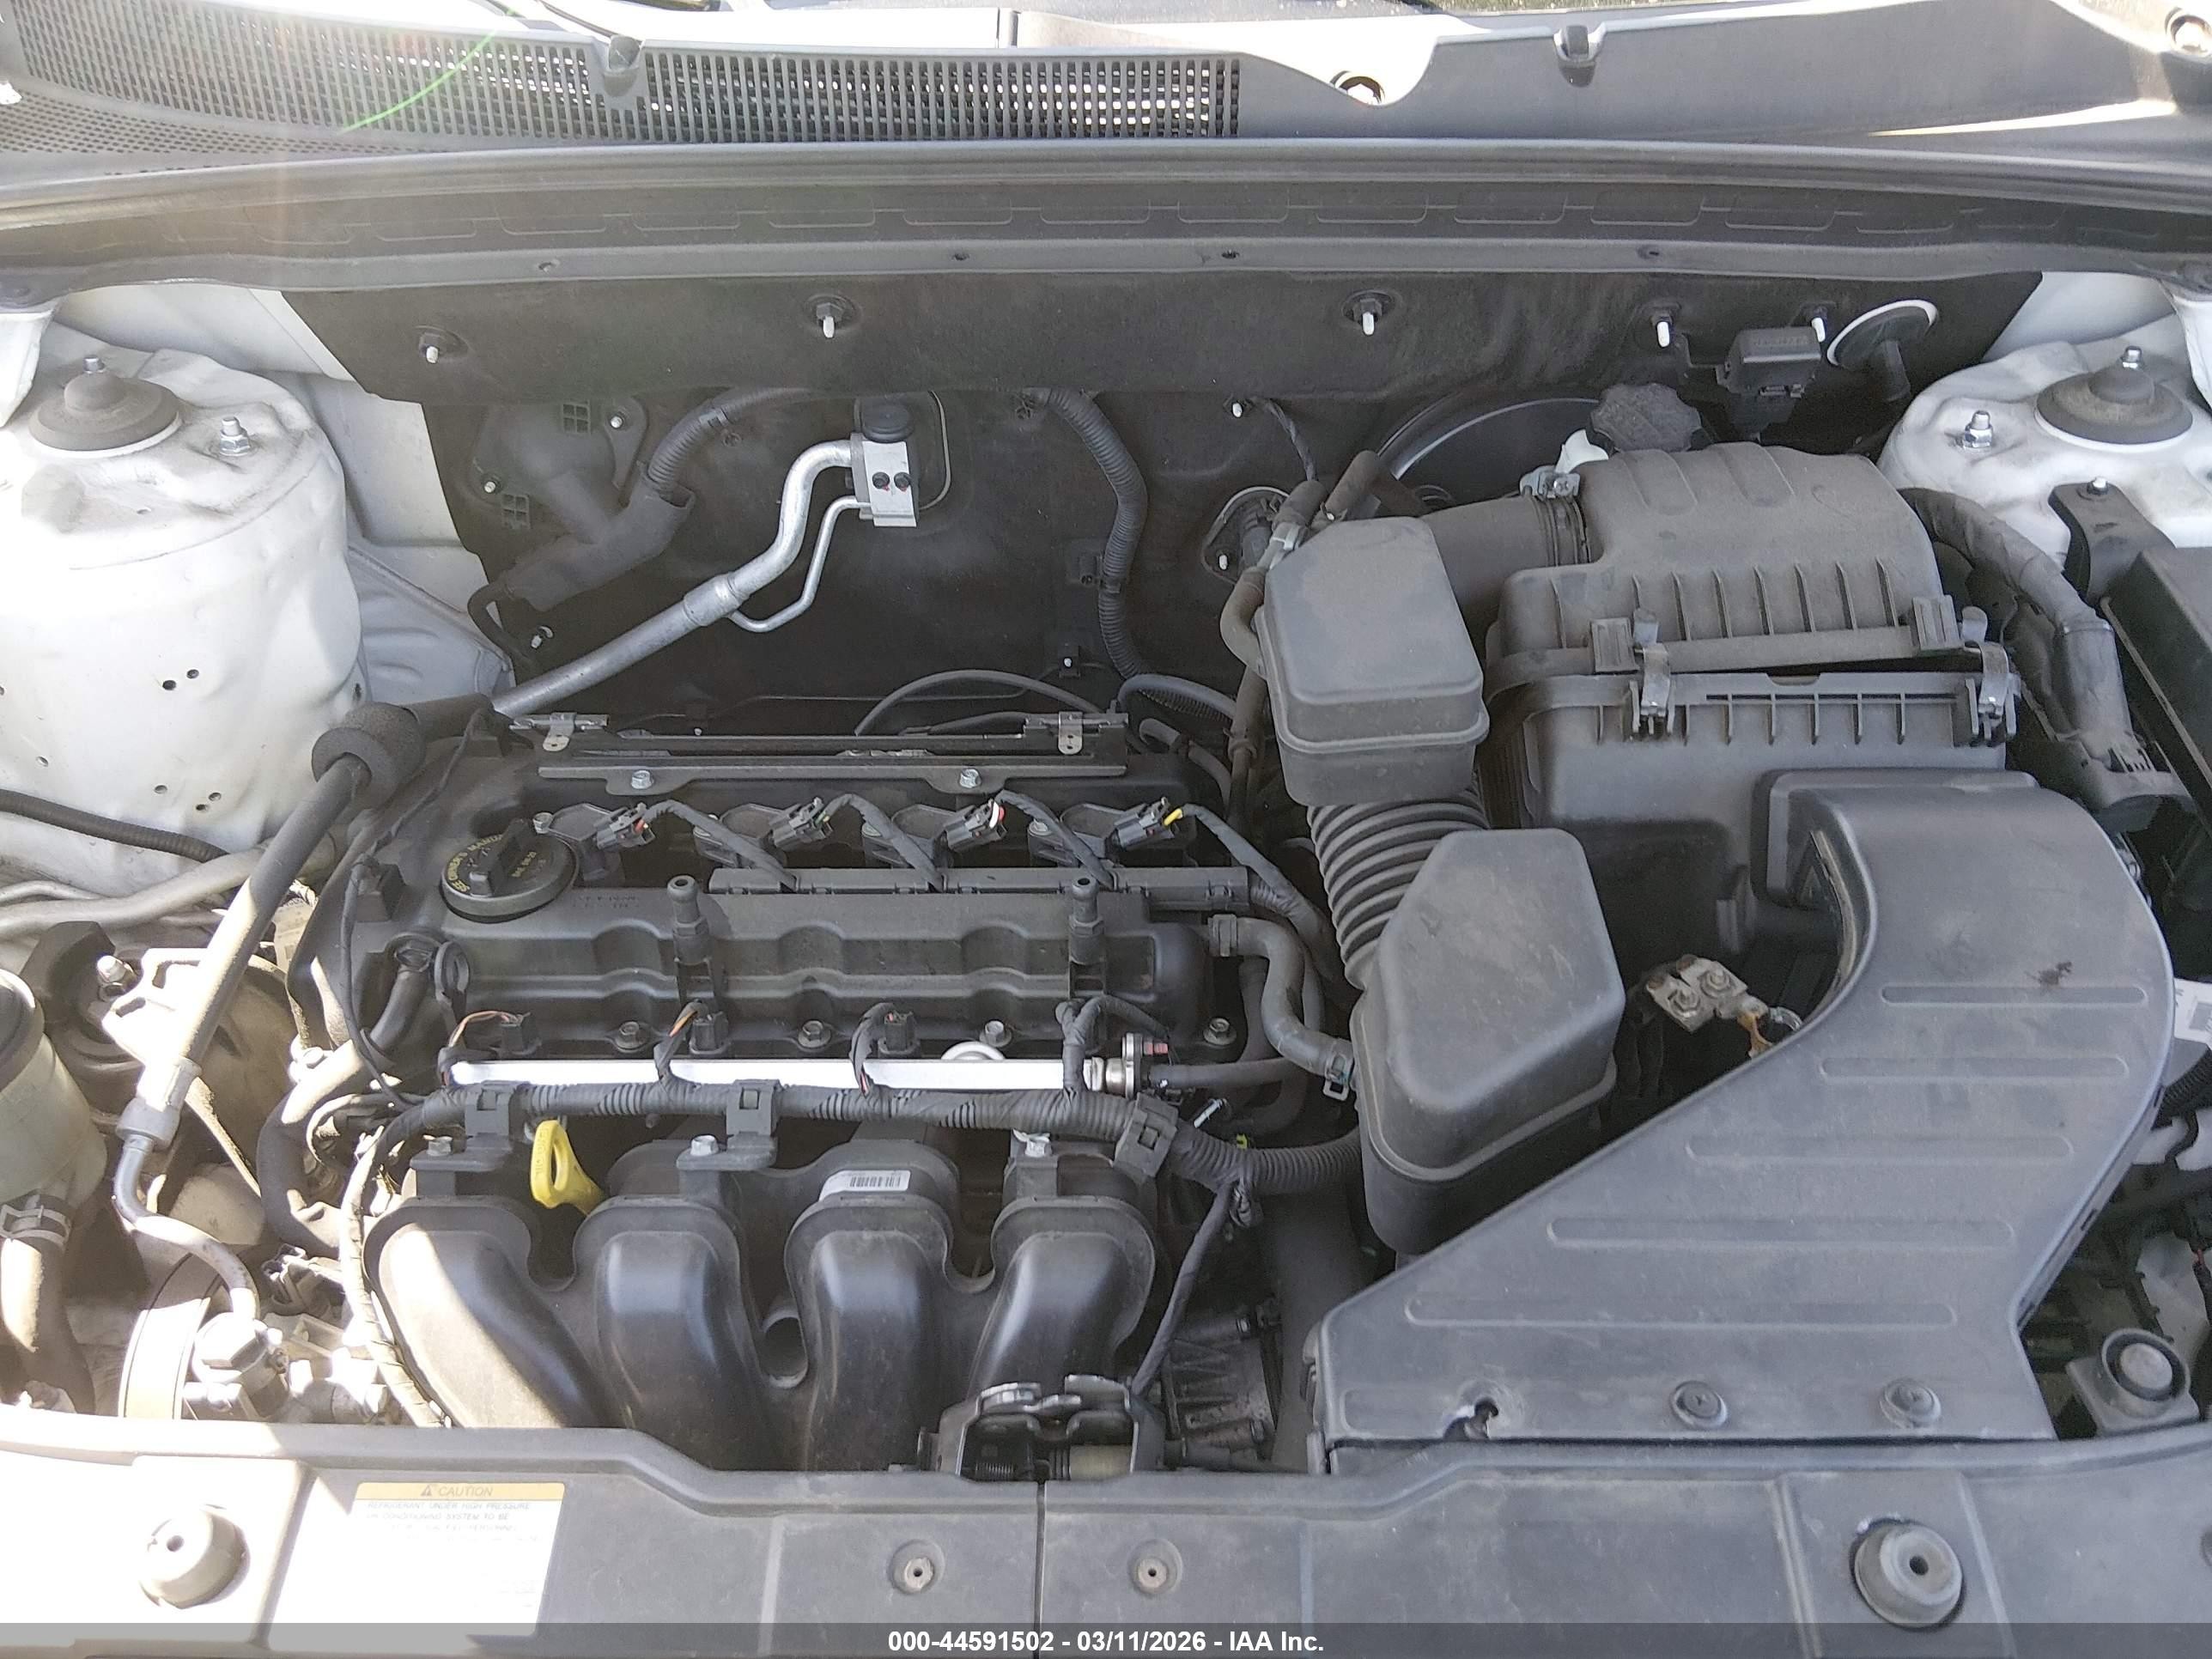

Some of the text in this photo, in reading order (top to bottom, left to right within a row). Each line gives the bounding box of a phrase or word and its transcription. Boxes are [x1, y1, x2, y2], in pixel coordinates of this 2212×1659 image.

[438, 1486, 494, 1497] CAUTION
[446, 1512, 480, 1521] SYSTEM
[483, 1512, 495, 1521] TO
[498, 1512, 509, 1521] BE
